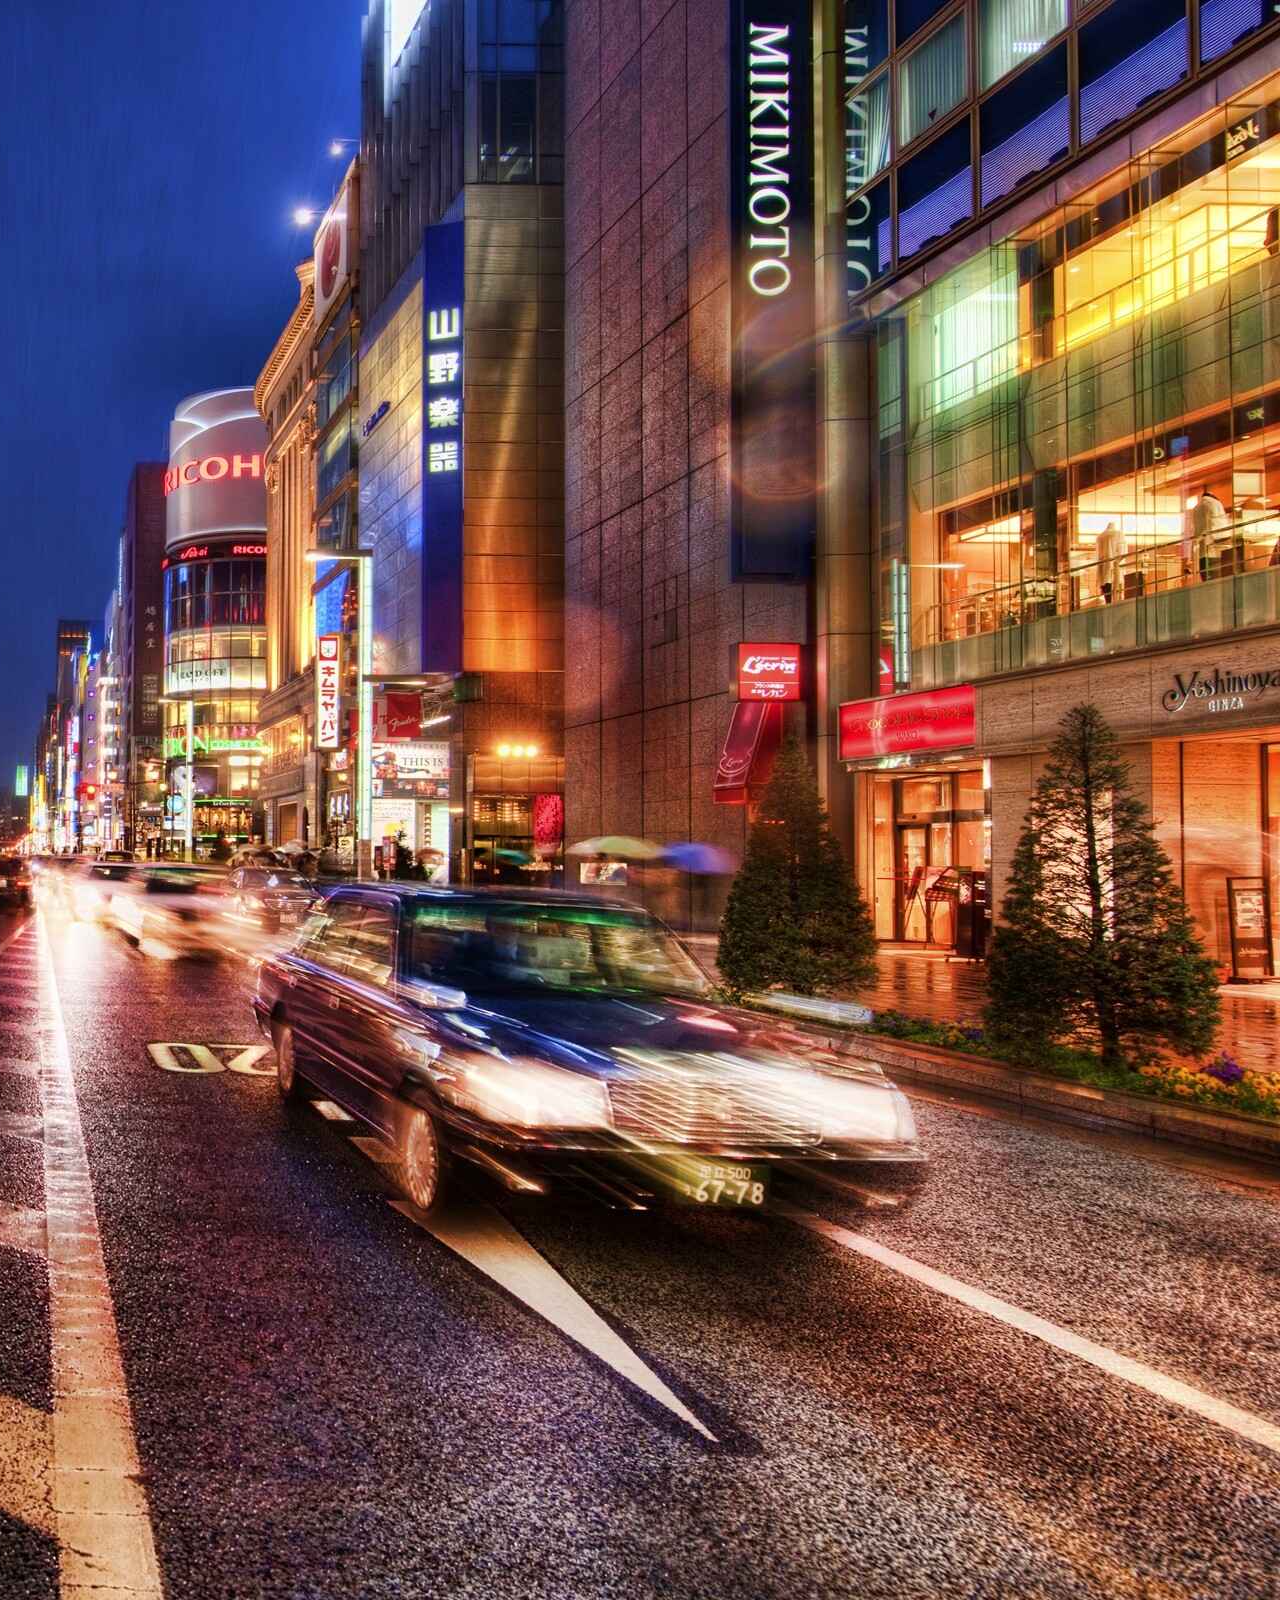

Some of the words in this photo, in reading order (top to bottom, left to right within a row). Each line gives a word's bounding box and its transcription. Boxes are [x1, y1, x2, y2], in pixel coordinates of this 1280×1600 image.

[749, 22, 791, 296] MIKIMOTO
[429, 307, 460, 473] 山野楽器
[164, 454, 260, 497] RICOH
[177, 669, 202, 679] RAND
[321, 665, 337, 742] キムラヤのパン
[1162, 669, 1280, 712] Yoshinoya
[1208, 697, 1244, 712] GINZA
[389, 715, 418, 732] Fender
[849, 712, 922, 733] Chocolate
[923, 704, 970, 721] Shop
[401, 757, 430, 767] THIS
[433, 757, 443, 767] IS
[727, 1167, 751, 1180] 500
[696, 1180, 765, 1205] 67-78
